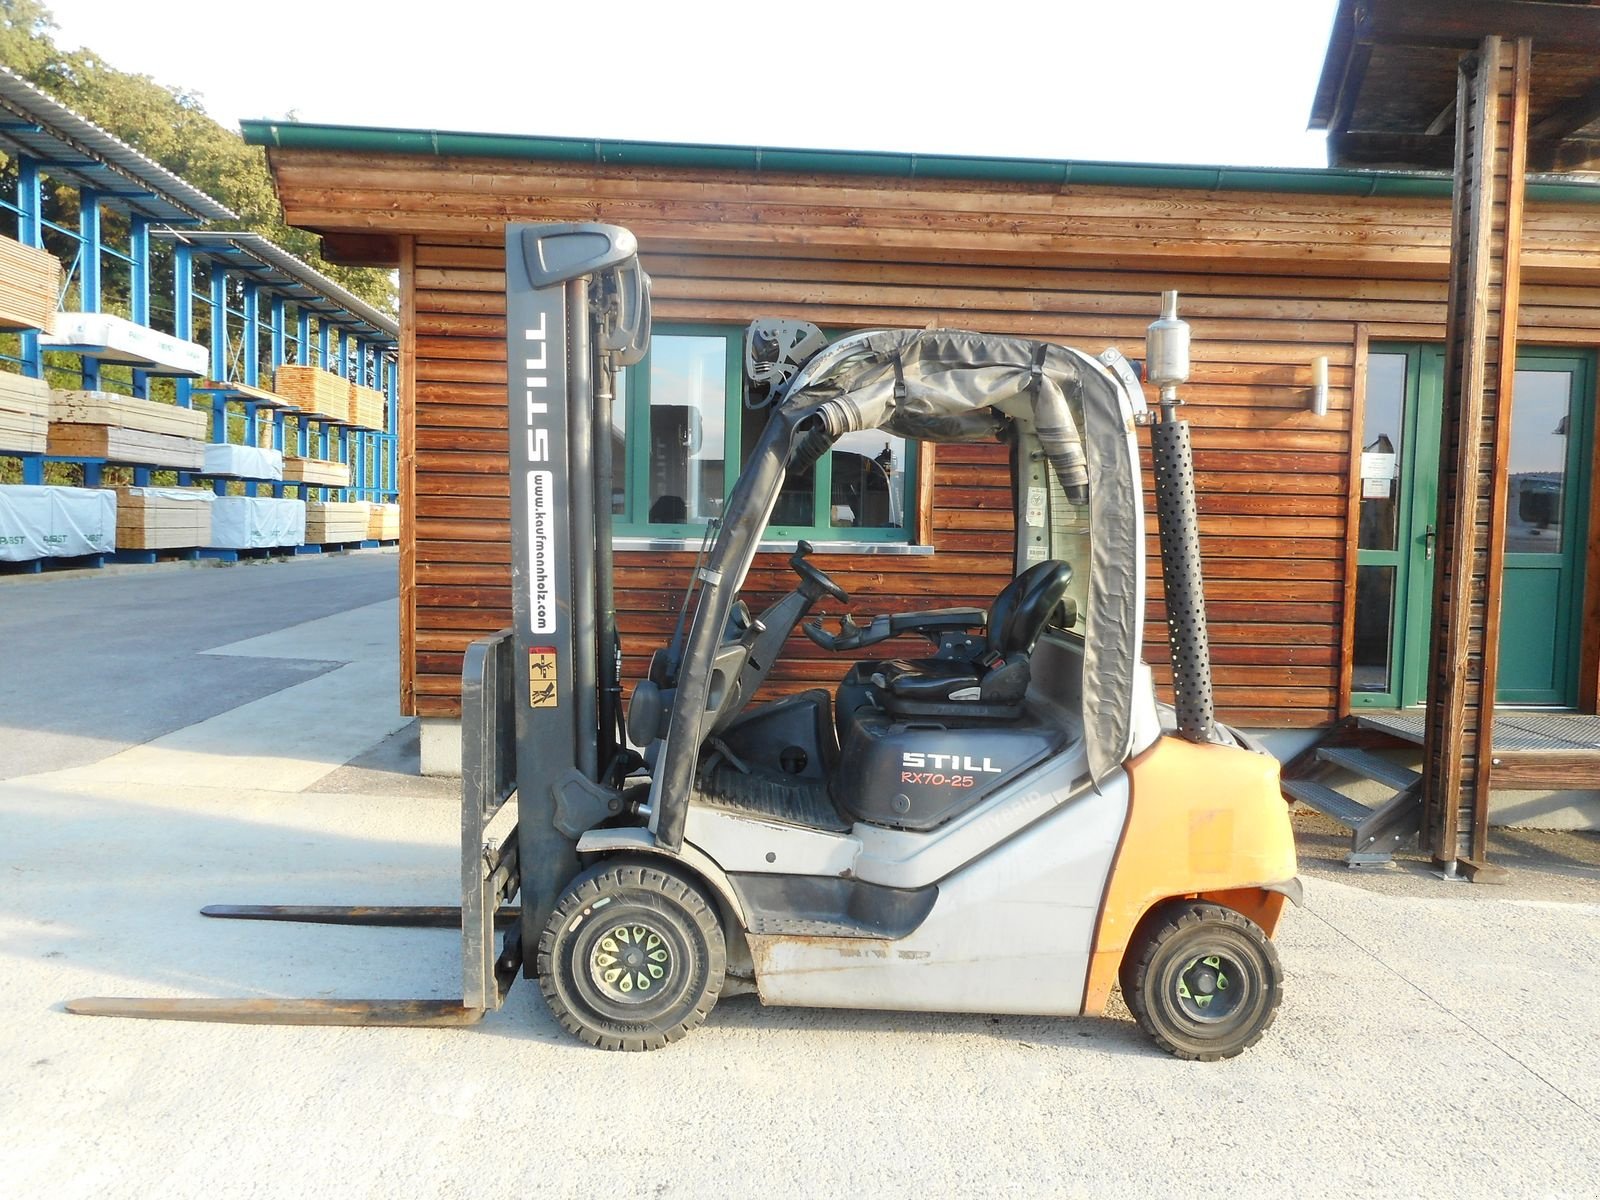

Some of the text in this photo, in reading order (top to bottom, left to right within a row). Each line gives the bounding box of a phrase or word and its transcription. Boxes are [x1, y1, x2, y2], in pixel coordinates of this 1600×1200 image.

[525, 312, 549, 462] STILL
[534, 474, 549, 629] www.kaufmannholz.com
[901, 771, 974, 788] RX70-25
[902, 752, 1002, 773] STILL
